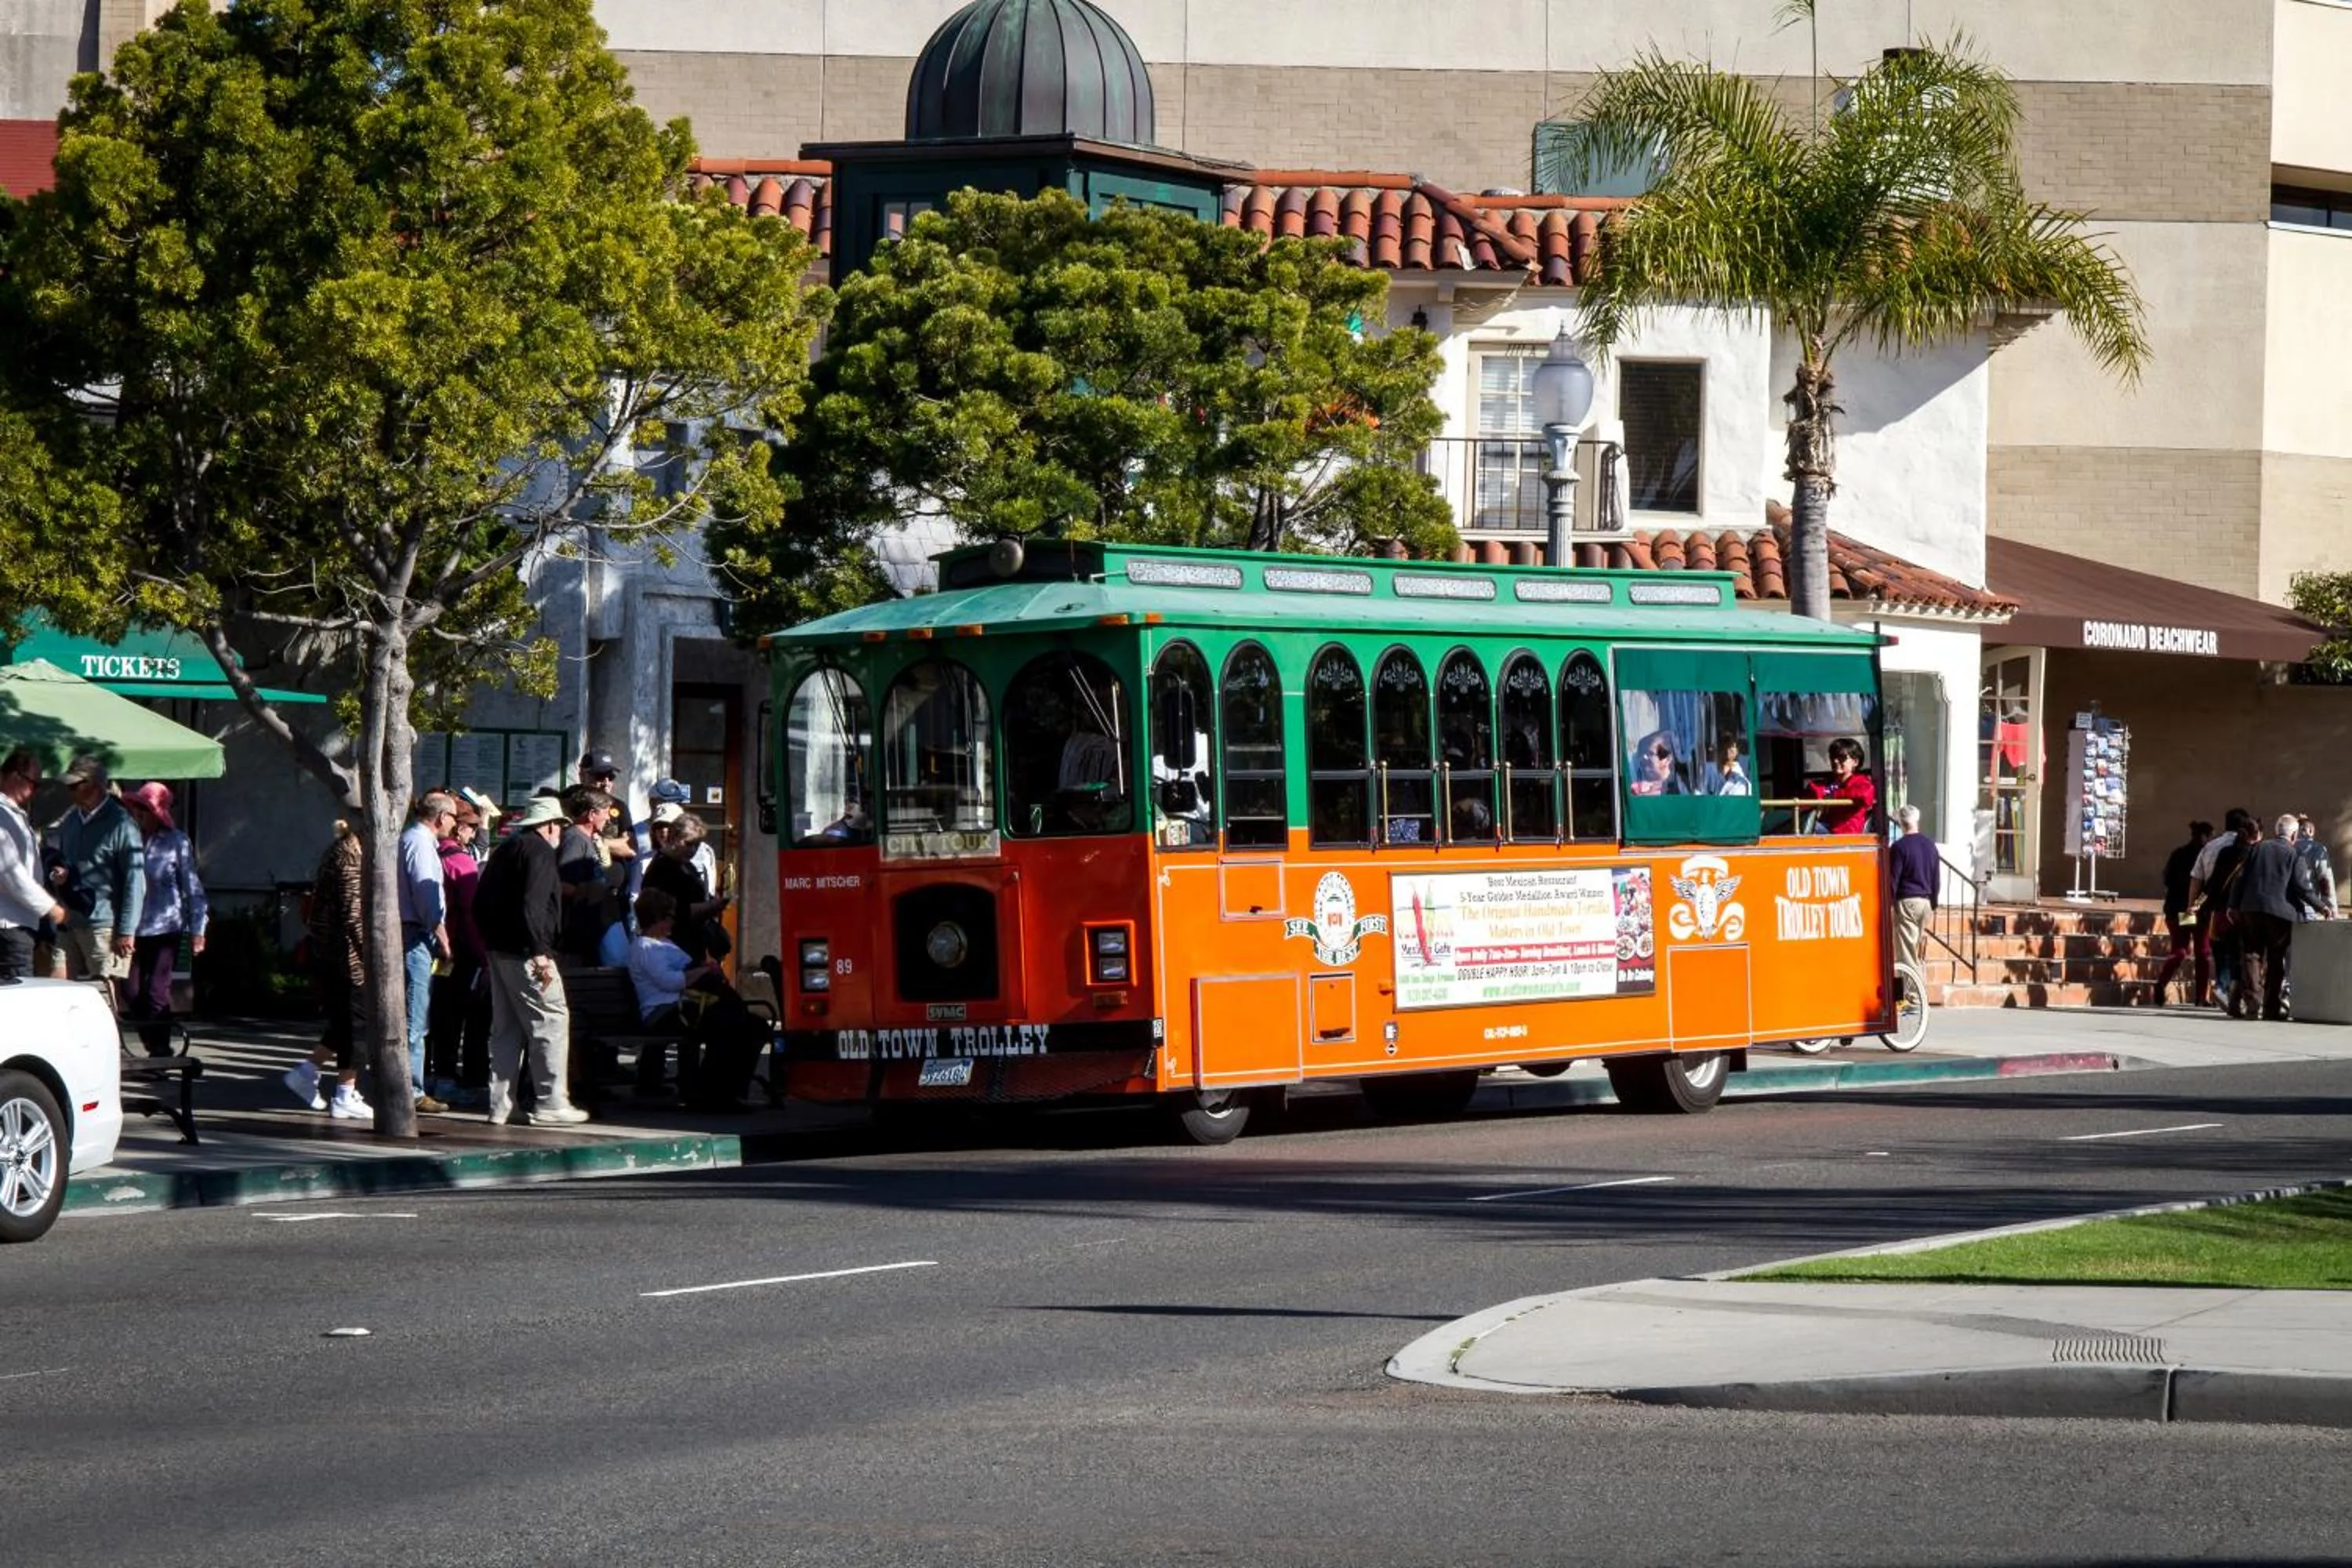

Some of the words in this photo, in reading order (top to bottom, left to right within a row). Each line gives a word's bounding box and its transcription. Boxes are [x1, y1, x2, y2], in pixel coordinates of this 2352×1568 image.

[2083, 620, 2147, 650] CORONADO
[2148, 625, 2218, 655] BEACHWEAR
[81, 655, 180, 680] TICKETS
[887, 833, 931, 854] CITY
[941, 831, 993, 851] TOUR
[784, 876, 811, 890] MARC
[816, 875, 861, 889] MITSCHER
[1787, 866, 1812, 898] OLD
[1812, 865, 1850, 898] TOWN
[1289, 920, 1309, 935] SEE
[1774, 893, 1826, 942] TROLLEY
[1828, 891, 1864, 938] TOURS
[836, 959, 853, 975] 89
[838, 1029, 869, 1059] OLD
[877, 1028, 938, 1059] TOWN
[949, 1023, 1050, 1057] TROLLEY
